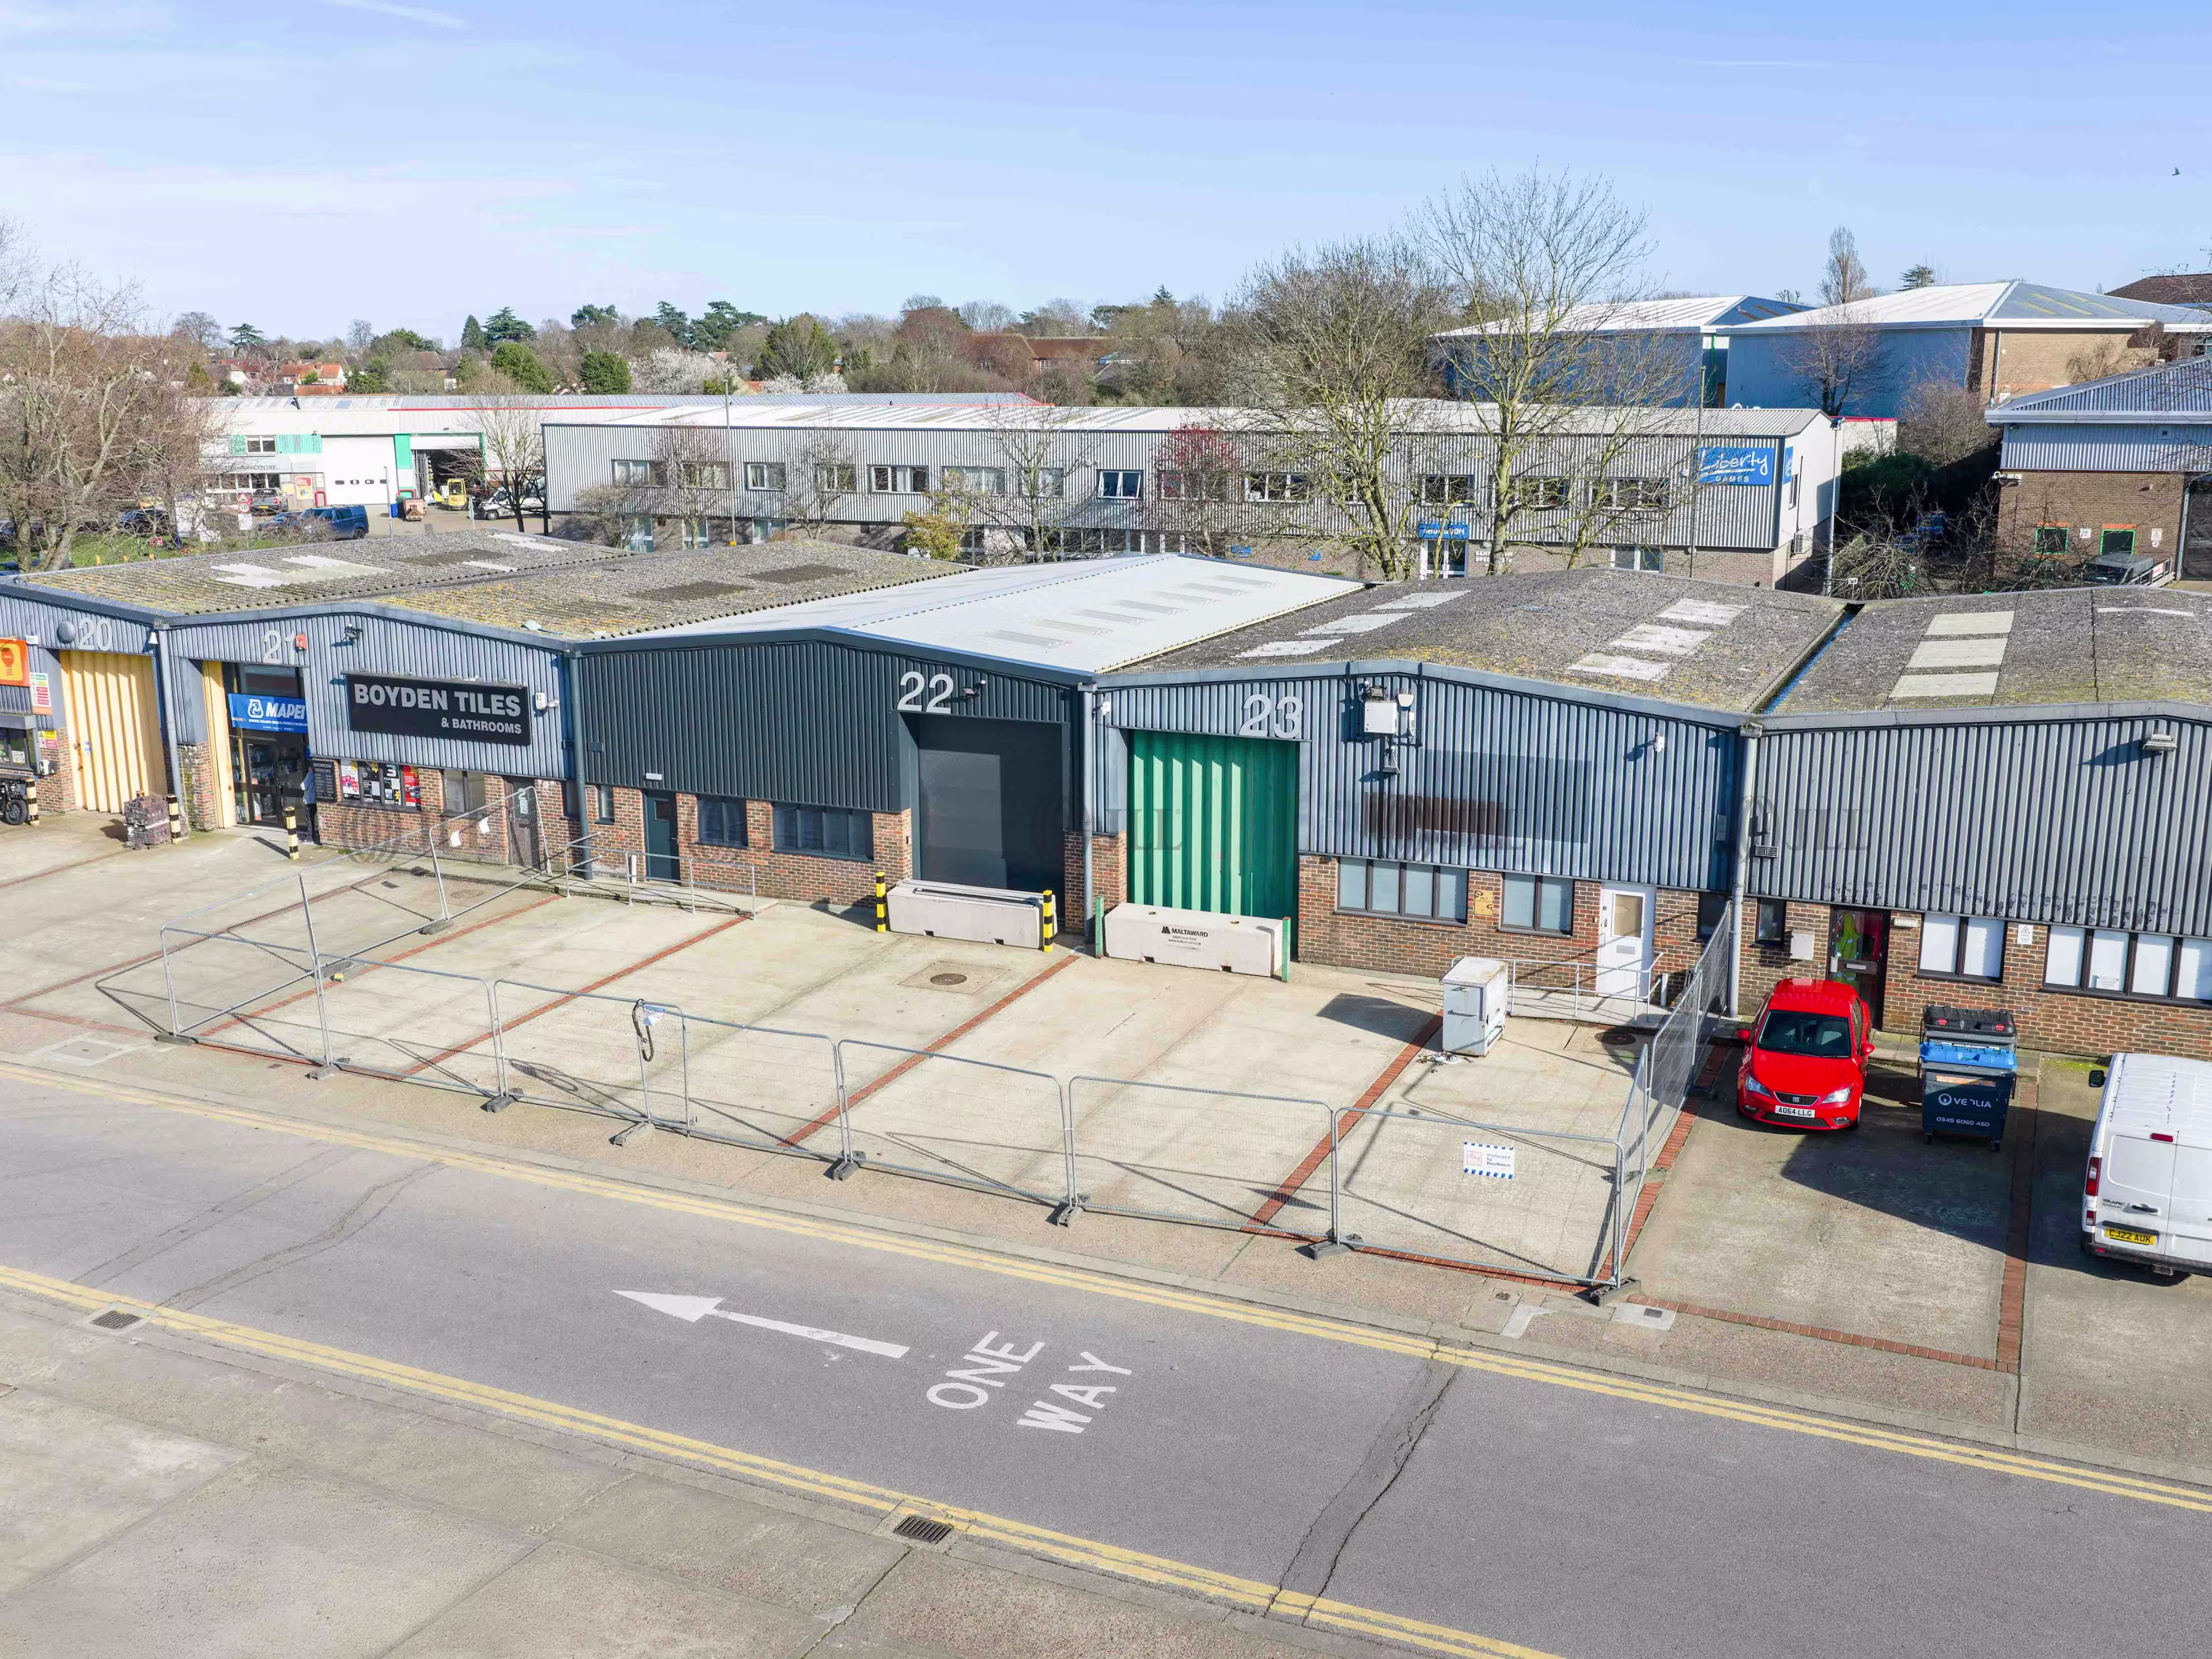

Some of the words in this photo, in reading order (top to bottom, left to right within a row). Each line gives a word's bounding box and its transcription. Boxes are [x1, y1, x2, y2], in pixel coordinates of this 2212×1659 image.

[1699, 449, 1768, 476] Liberty
[79, 618, 112, 651] 20
[263, 630, 296, 665] 21
[354, 684, 449, 711] BOYDEN
[454, 691, 521, 718] TILES
[897, 671, 954, 714] 22
[266, 702, 306, 720] MAPEI
[441, 718, 450, 729] &
[452, 718, 522, 734] BATHROOMS
[1238, 694, 1304, 739] 23
[387, 764, 397, 778] 3
[1172, 928, 1208, 937] MALTAWARD
[1778, 1107, 1796, 1115] AO64
[2109, 1229, 2132, 1240] CJ22
[2134, 1234, 2152, 1243] AUK
[926, 1331, 1046, 1410] ONE
[1017, 1351, 1132, 1434] WAY
